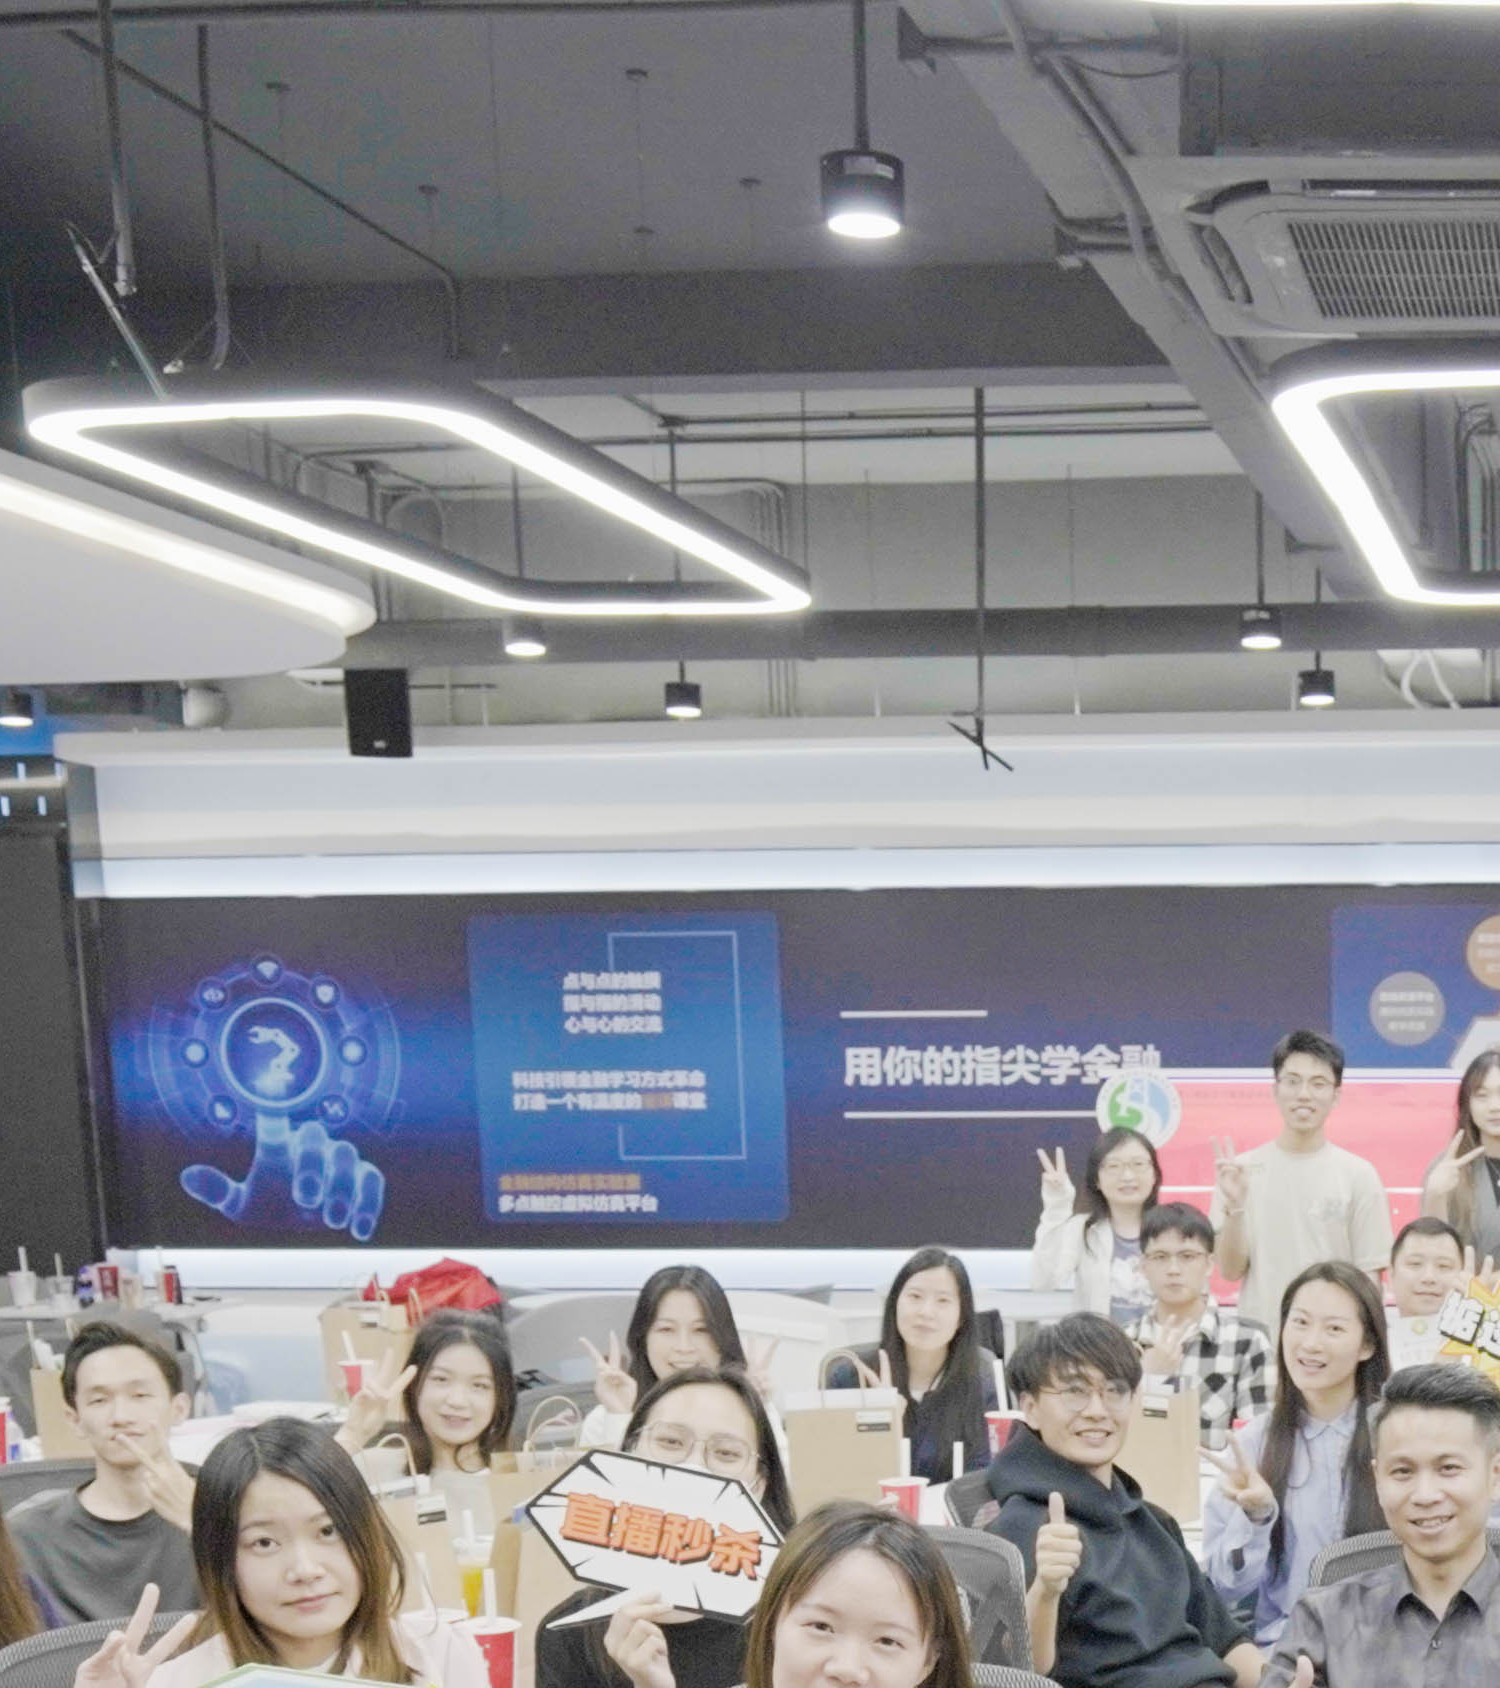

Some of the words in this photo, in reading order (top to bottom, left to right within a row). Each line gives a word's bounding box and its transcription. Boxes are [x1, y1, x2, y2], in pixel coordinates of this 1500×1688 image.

[844, 1043, 1161, 1087] 用你的指尖学金融
[560, 1492, 762, 1580] 直播秒杀
